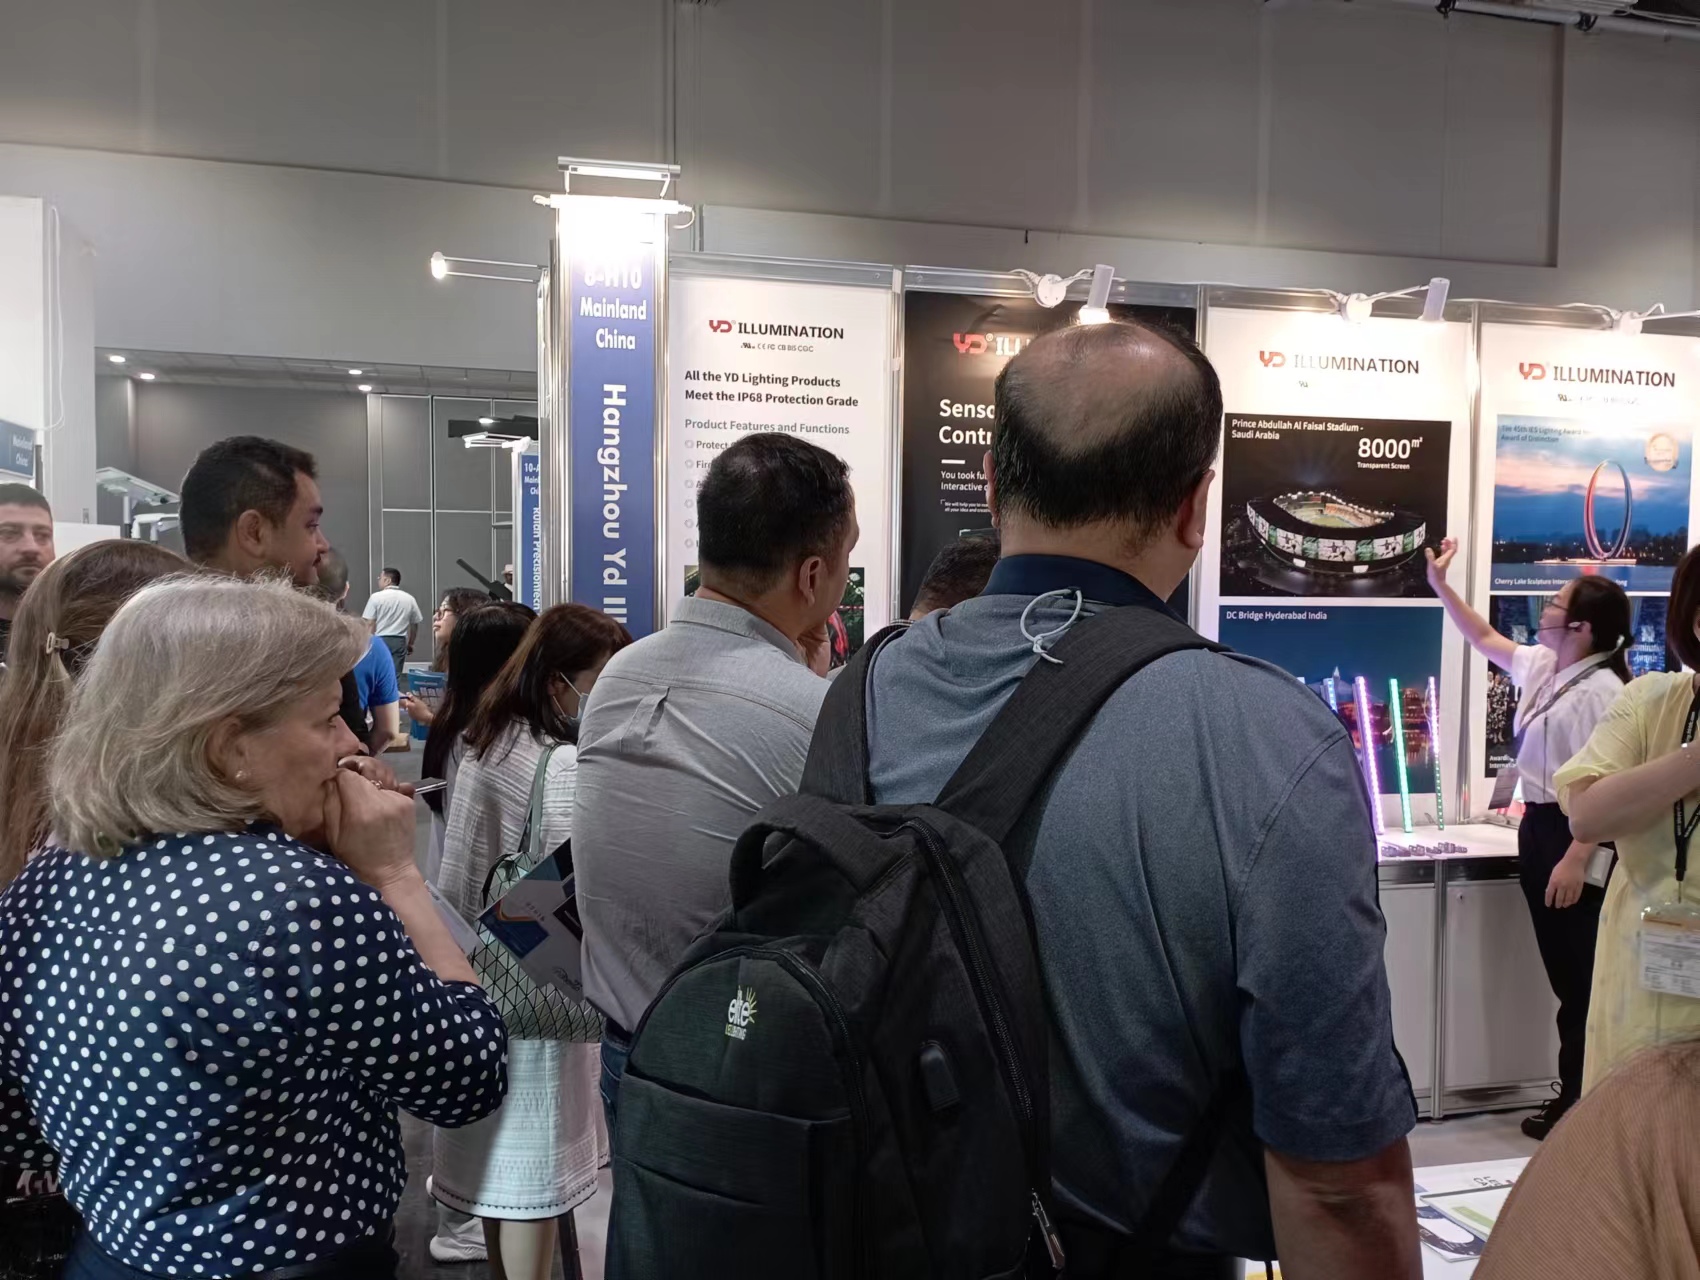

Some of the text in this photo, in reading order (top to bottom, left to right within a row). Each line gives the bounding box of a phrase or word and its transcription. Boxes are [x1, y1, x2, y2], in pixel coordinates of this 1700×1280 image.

[580, 297, 647, 320] Mainland
[709, 320, 844, 339] YD ILLUMINATION
[595, 328, 636, 350] China
[1259, 350, 1419, 374] YD ILLUMINATION
[685, 371, 841, 387] All the YD Lighting Products
[1519, 362, 1676, 388] YD ILLUMINATION
[685, 390, 859, 407] Meet the IP68 Protection Grade
[684, 419, 850, 434] Product Features and Functions
[1232, 419, 1256, 429] Prince
[1258, 420, 1292, 430] Abdullah
[1294, 421, 1302, 430] Al
[1303, 422, 1326, 431] Faisal
[1327, 423, 1359, 432] Stadium
[1231, 430, 1280, 440] Saudi Arabia
[696, 440, 729, 450] Protect
[597, 384, 628, 538] Hangzhou
[1357, 461, 1391, 470] Transparent
[941, 471, 956, 479] You
[957, 471, 975, 480] took
[941, 482, 983, 491] Interactive
[603, 548, 628, 585] Yd
[1226, 611, 1328, 621] DC Bridge Hyderabad India
